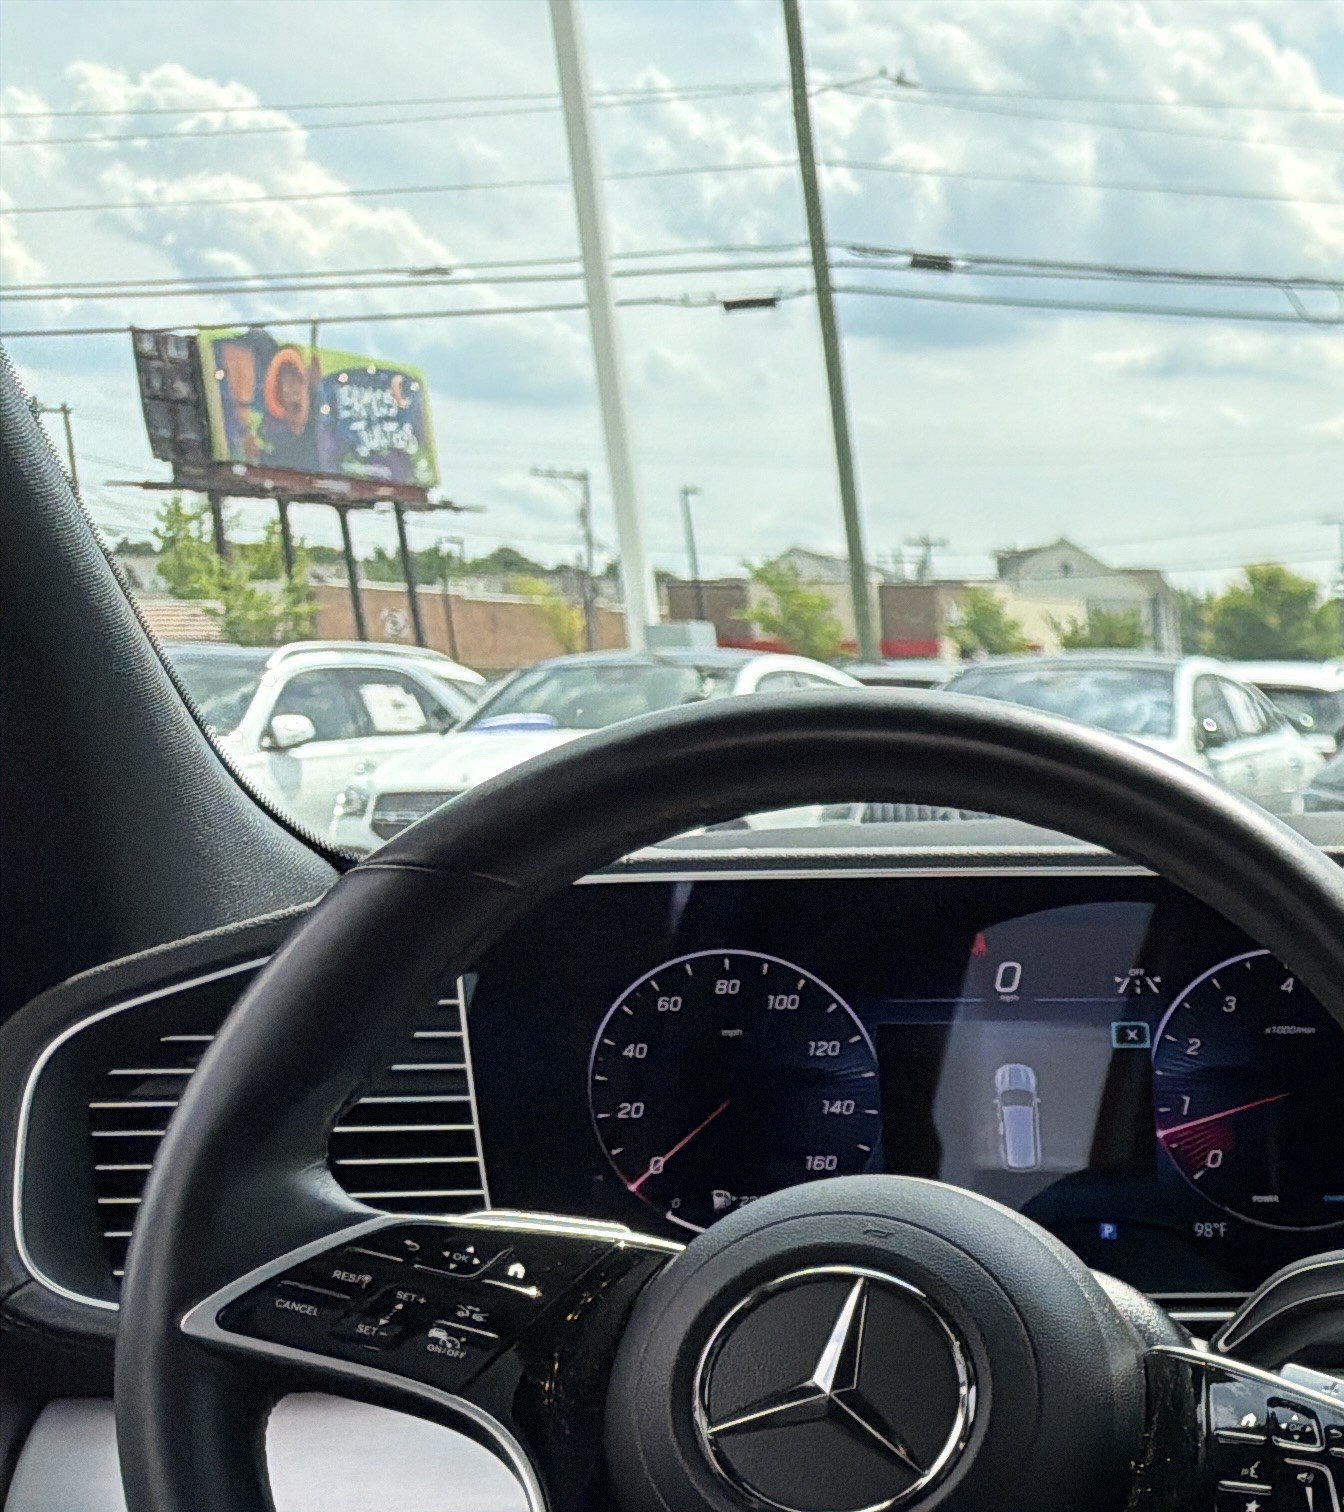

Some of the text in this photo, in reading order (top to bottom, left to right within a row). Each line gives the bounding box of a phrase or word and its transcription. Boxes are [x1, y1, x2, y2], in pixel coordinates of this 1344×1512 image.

[994, 961, 1023, 994] 0
[1279, 977, 1294, 994] 4
[714, 979, 741, 995] 80
[657, 996, 683, 1012] 60
[767, 994, 800, 1011] 100
[1222, 996, 1237, 1014] 3
[622, 1043, 648, 1059] 40
[807, 1041, 841, 1057] 120
[1185, 1038, 1201, 1055] 2
[617, 1102, 645, 1119] 20
[821, 1099, 855, 1115] 140
[1181, 1096, 1190, 1115] 1
[649, 1157, 666, 1174] 0
[805, 1156, 838, 1171] 160
[1205, 1149, 1222, 1168] 0
[1194, 1222, 1227, 1238] 98°F
[452, 1252, 469, 1263] OK
[396, 1290, 417, 1303] SET
[275, 1298, 318, 1317] CANCEL
[355, 1323, 379, 1336] SET
[426, 1343, 467, 1359] ON/OFF
